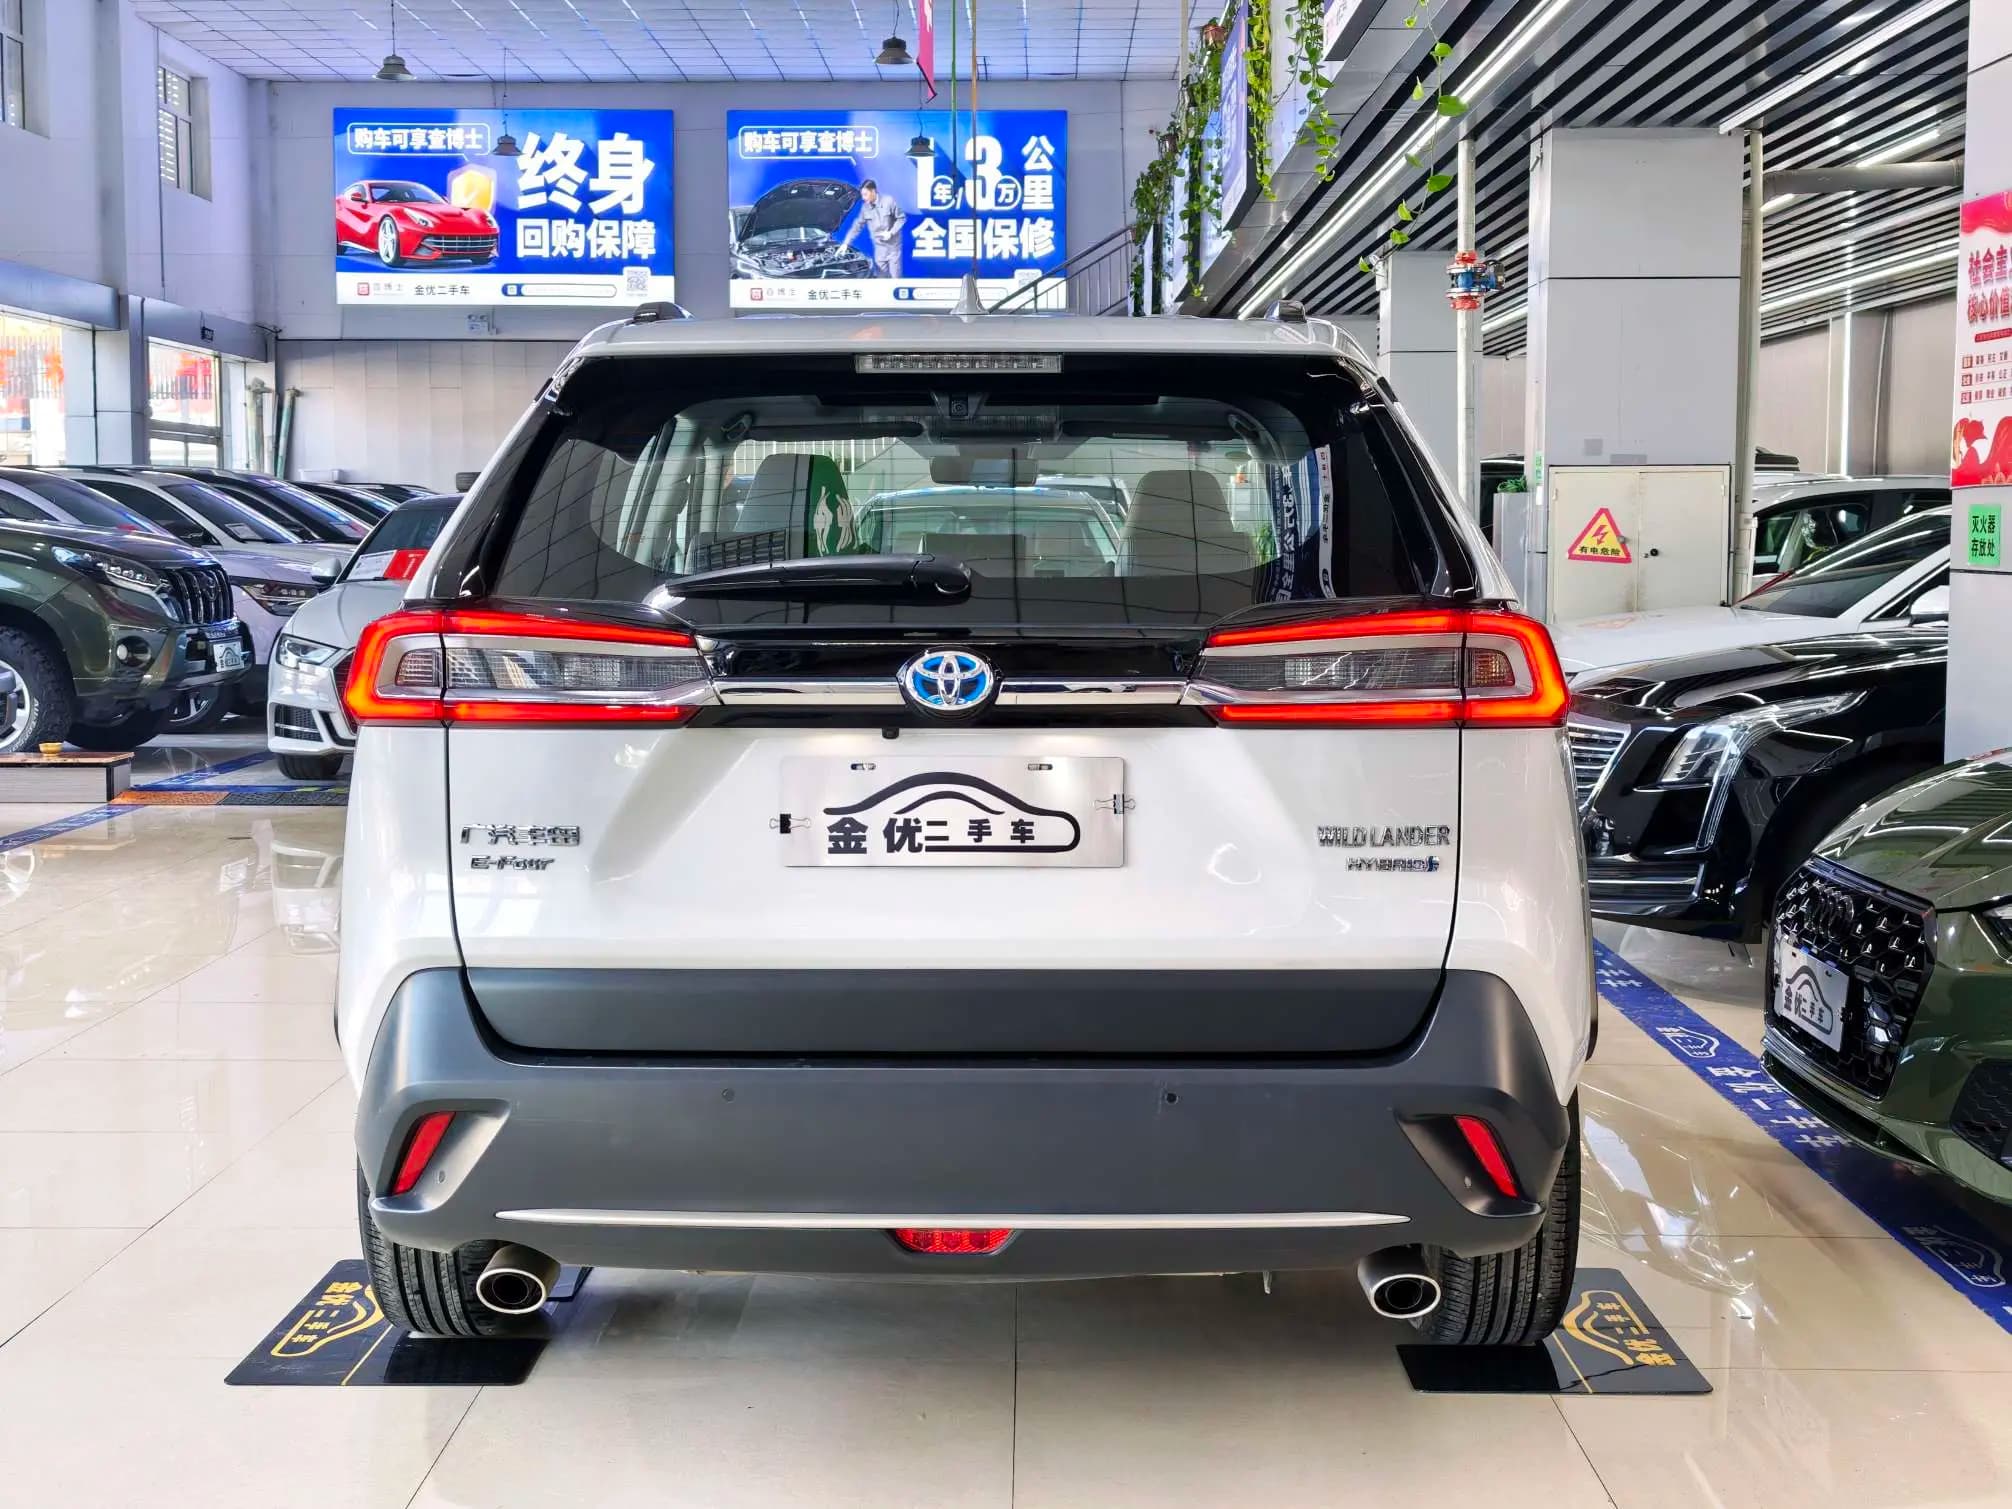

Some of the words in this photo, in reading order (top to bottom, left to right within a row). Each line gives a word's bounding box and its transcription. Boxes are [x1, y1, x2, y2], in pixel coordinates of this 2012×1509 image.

[354, 128, 483, 150] 购车可享查博士
[744, 131, 873, 153] 购车可享查博士
[516, 132, 656, 214] 终身
[516, 218, 656, 260] 回购保障
[911, 218, 1056, 260] 全国保修
[1968, 244, 2012, 290] 社会主
[1968, 287, 2012, 325] 核心价值
[1971, 514, 1996, 534] 灭火器
[1579, 545, 1621, 557] 有电危险
[1971, 537, 1996, 557] 存放处
[827, 816, 1036, 855] 金优二手车
[470, 855, 555, 870] E-Four
[1347, 856, 1427, 872] HYBRID
